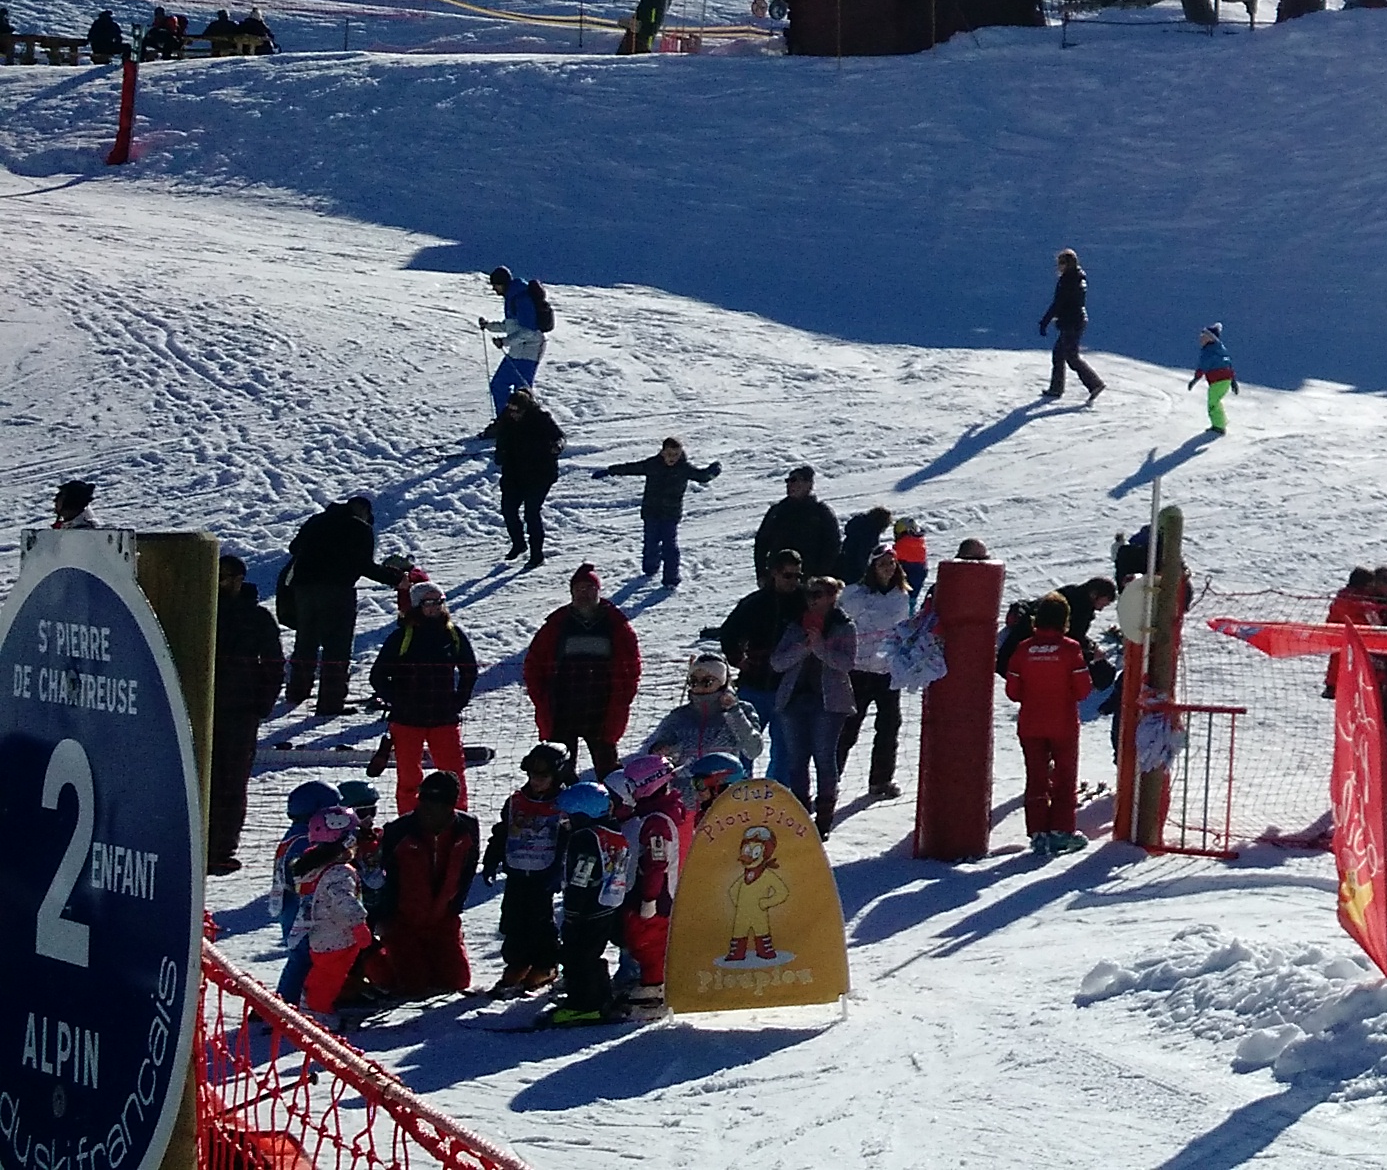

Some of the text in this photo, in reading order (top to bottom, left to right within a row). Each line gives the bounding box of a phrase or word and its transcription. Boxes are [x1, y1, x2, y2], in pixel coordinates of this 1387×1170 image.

[56, 622, 111, 662] PIERRE
[13, 664, 32, 699] DE
[731, 785, 775, 803] Club
[701, 805, 810, 843] Piou Piou
[35, 738, 94, 968] 2
[91, 841, 158, 901] ENFANT
[22, 1012, 99, 1089] ALPIN
